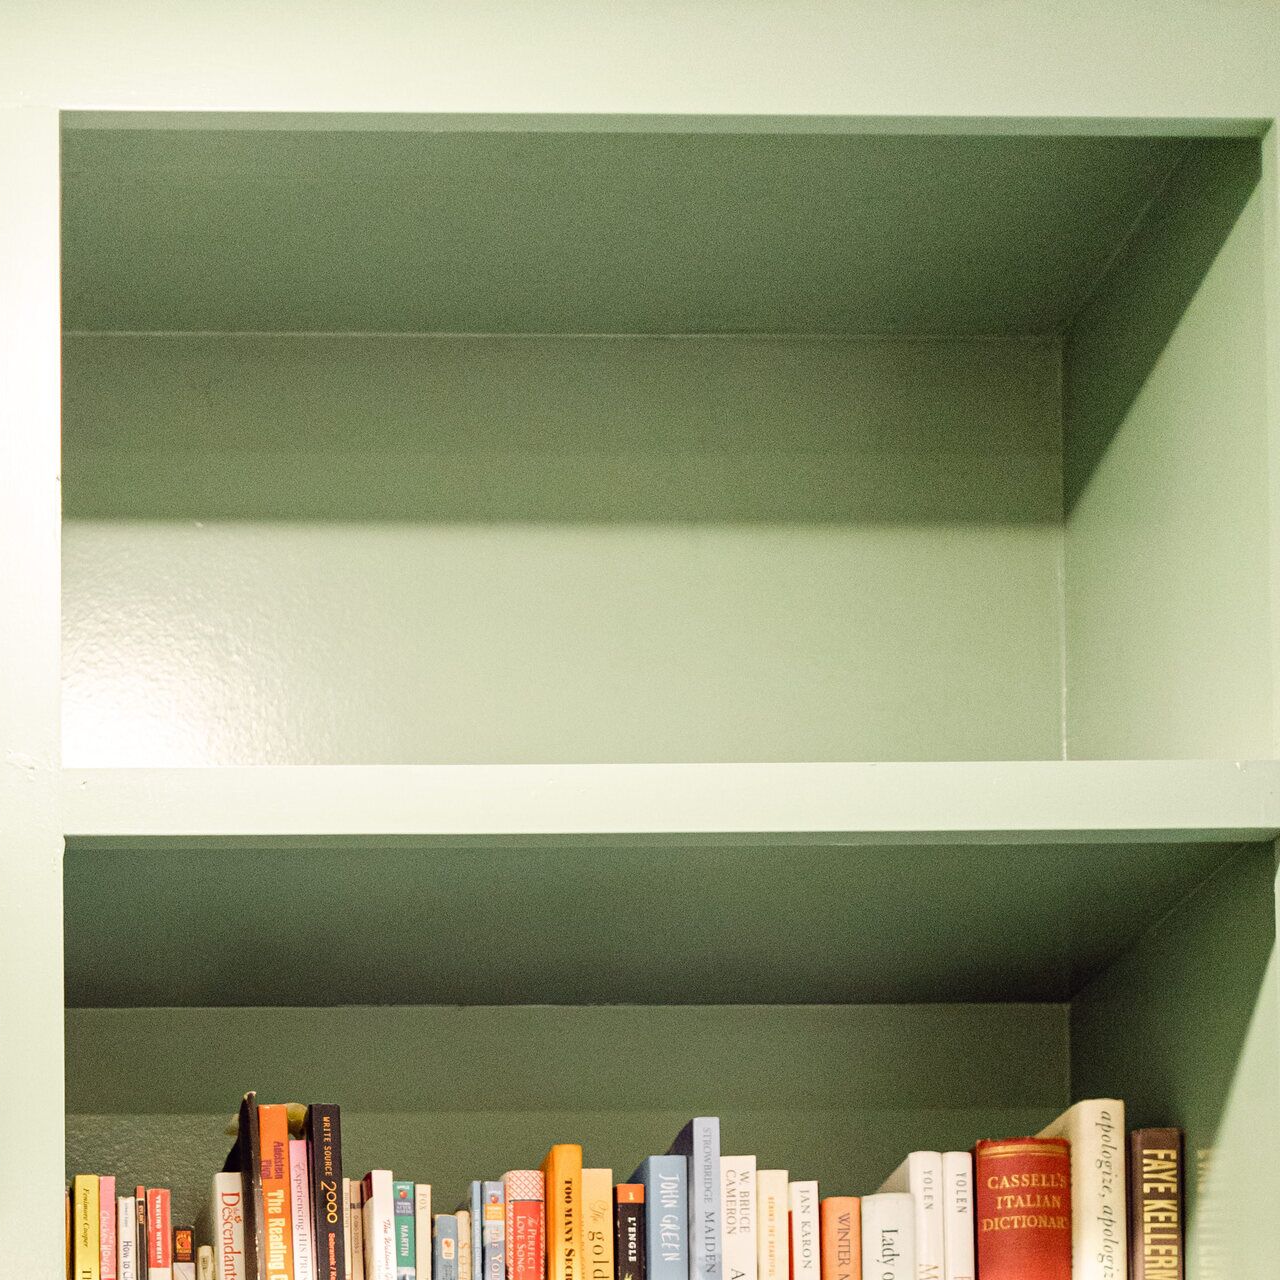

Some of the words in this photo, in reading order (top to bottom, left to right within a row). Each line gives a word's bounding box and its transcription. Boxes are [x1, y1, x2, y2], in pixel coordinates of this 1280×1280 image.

[322, 1116, 330, 1145] WRITE
[320, 1147, 331, 1176] SOURCE
[1142, 1149, 1177, 1194] FAYE
[319, 1181, 338, 1224] 2000
[658, 1174, 680, 1208] JOHN
[724, 1170, 737, 1234] CAMERON
[740, 1188, 750, 1234] BRUCE
[799, 1190, 809, 1214] JAN
[399, 1224, 409, 1257] MARTIN
[628, 1216, 637, 1262] L'ENGLE
[659, 1214, 681, 1262] GREEN
[801, 1220, 812, 1269] KARON
[836, 1212, 850, 1266] WINTER
